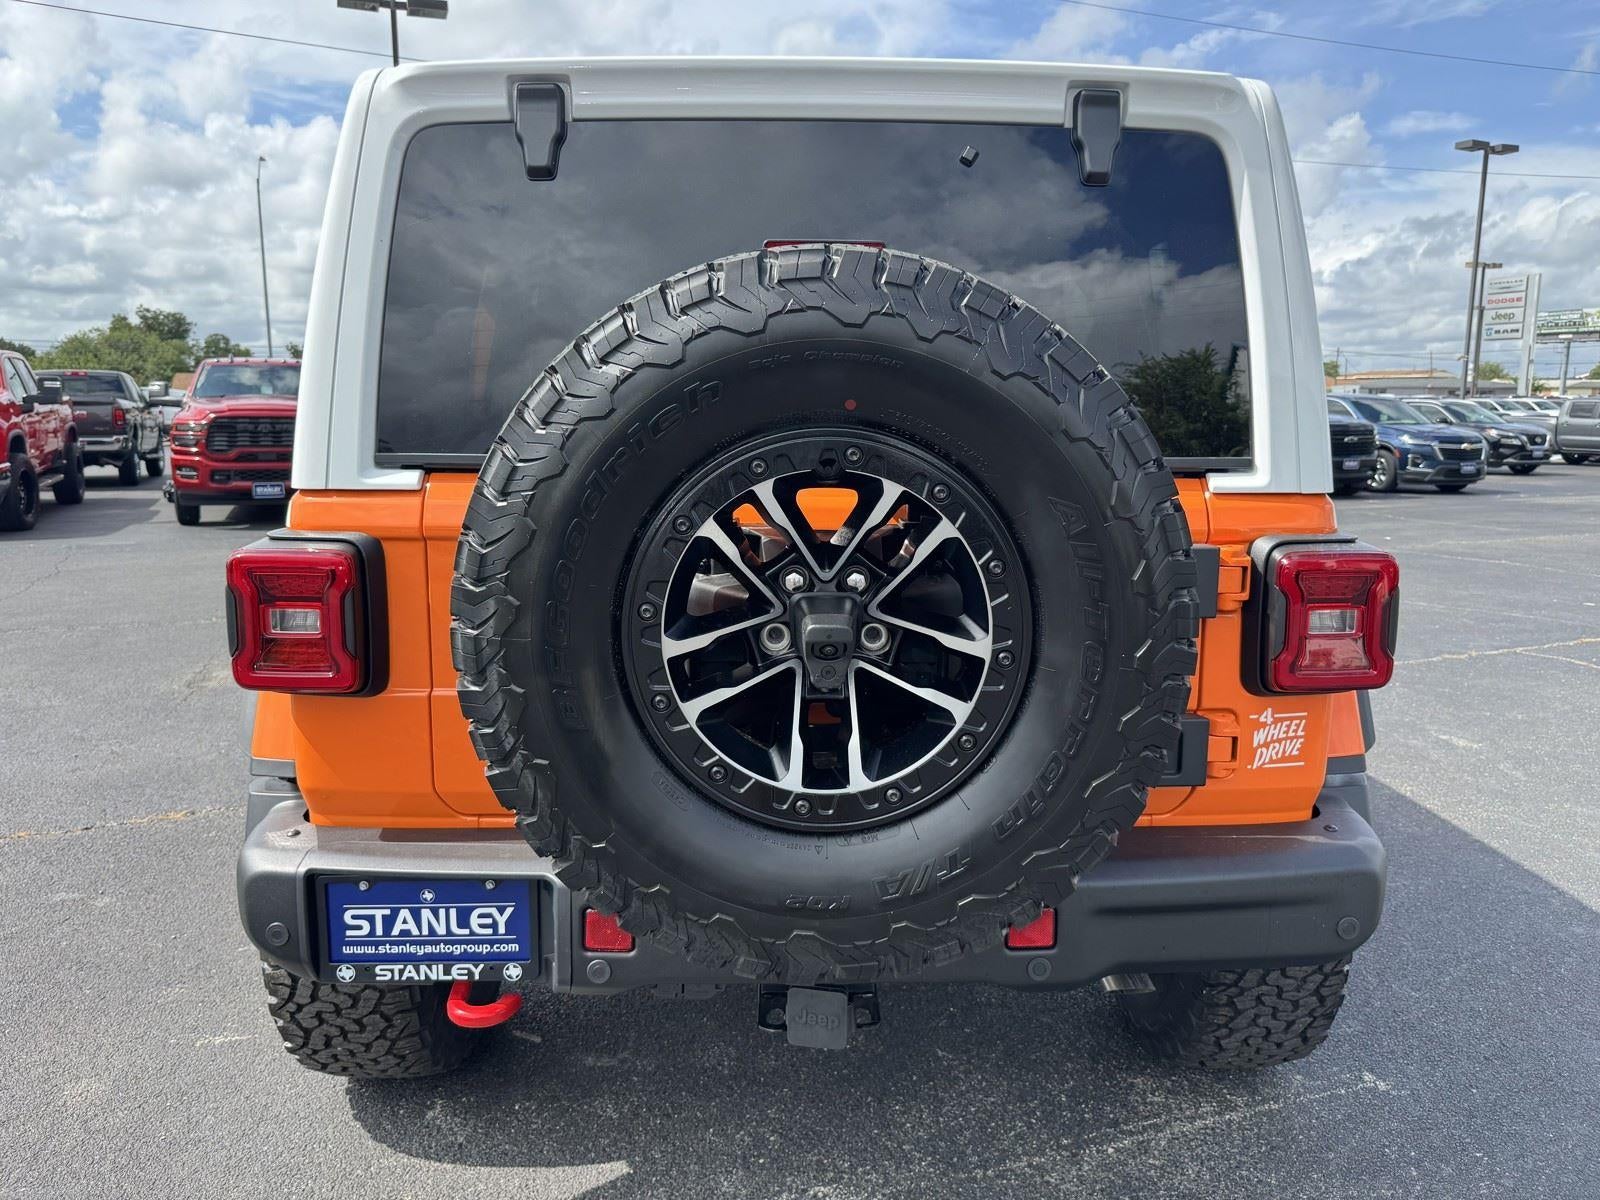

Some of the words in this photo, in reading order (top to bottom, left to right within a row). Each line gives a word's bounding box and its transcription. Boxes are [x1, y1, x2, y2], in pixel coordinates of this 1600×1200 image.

[1488, 297, 1522, 305] DODGE
[1491, 311, 1515, 321] Jeep
[1259, 707, 1273, 724] 4
[1253, 719, 1306, 748] WHEEL
[1252, 738, 1304, 770] DRIVE
[343, 906, 515, 937] STANLEY
[343, 942, 519, 956] www.stanleyautogroup.com
[374, 964, 485, 981] STANLEY
[795, 1008, 839, 1030] Jeep
